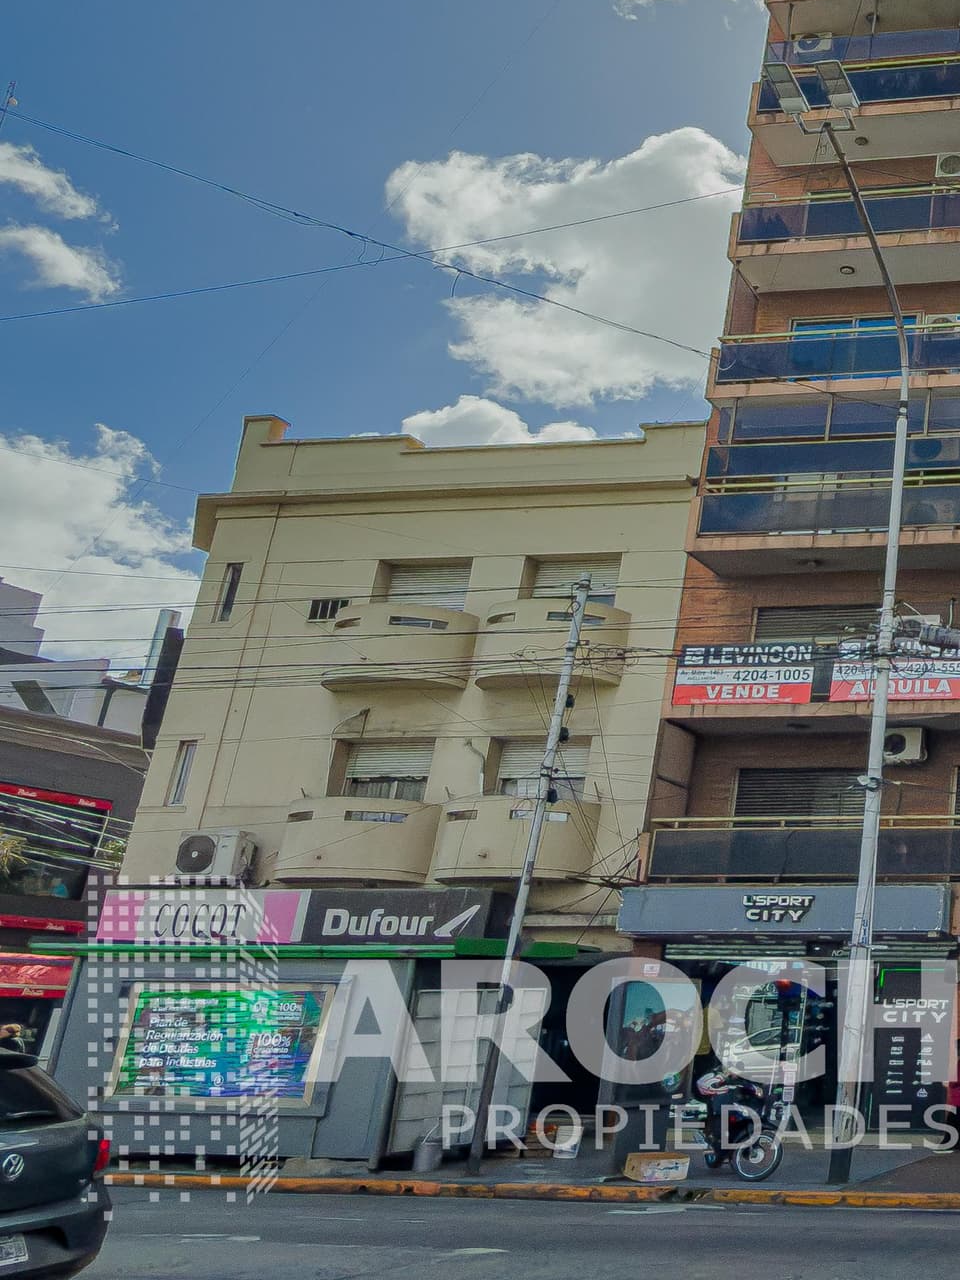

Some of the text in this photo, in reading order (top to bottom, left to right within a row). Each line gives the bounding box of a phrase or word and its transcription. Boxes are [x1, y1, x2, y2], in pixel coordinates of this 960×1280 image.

[732, 669, 810, 682] 4204-1005
[705, 684, 780, 699] VENDE
[742, 895, 814, 907] L'SPORT
[746, 909, 804, 922] CITY
[322, 908, 435, 936] Dufour
[883, 999, 949, 1009] L'SPORT
[174, 1017, 188, 1028] de
[883, 1011, 947, 1023] CITY
[257, 1032, 292, 1048] 100%
[138, 1057, 164, 1069] para
